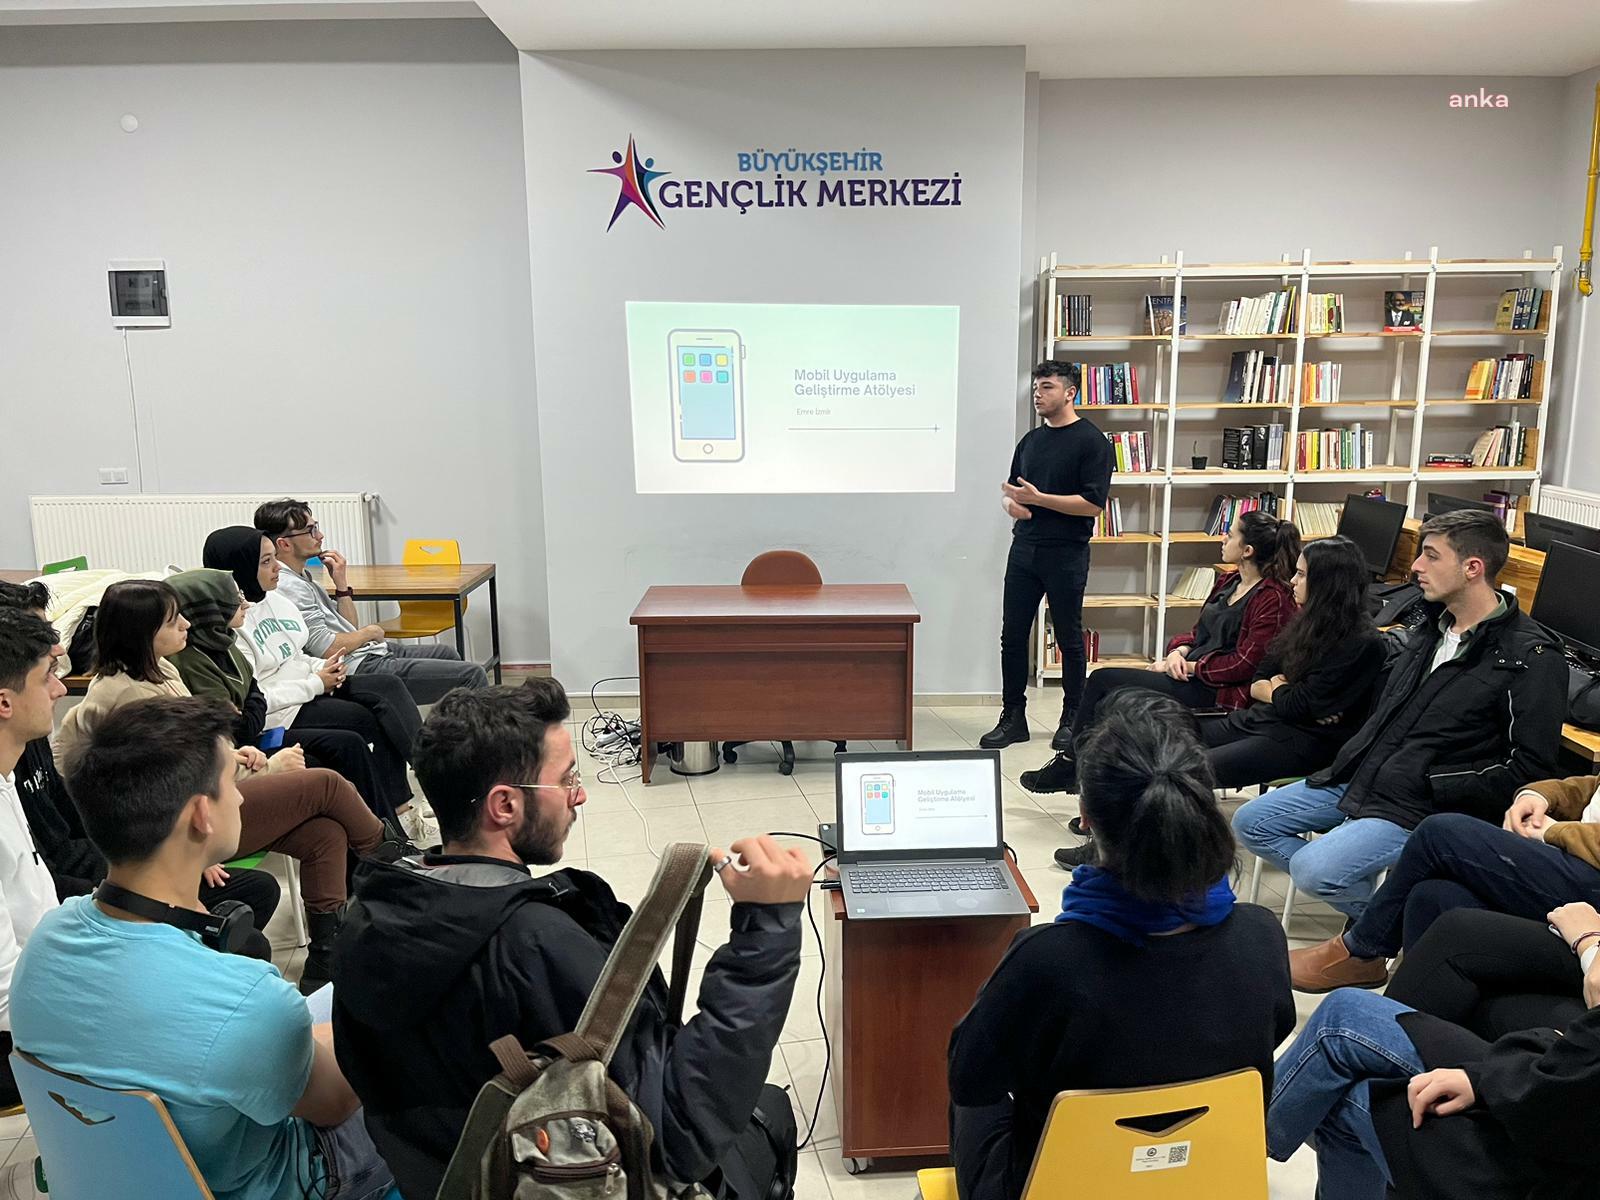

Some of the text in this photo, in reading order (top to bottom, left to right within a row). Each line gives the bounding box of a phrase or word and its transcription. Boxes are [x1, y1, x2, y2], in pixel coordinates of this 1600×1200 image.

[737, 147, 883, 175] BÜYÜKŞEHİR
[658, 172, 962, 214] GENÇLİK MERKEZİ
[794, 369, 897, 384] Mobil Uygulama
[794, 384, 916, 398] Geliştirme Atölyesi
